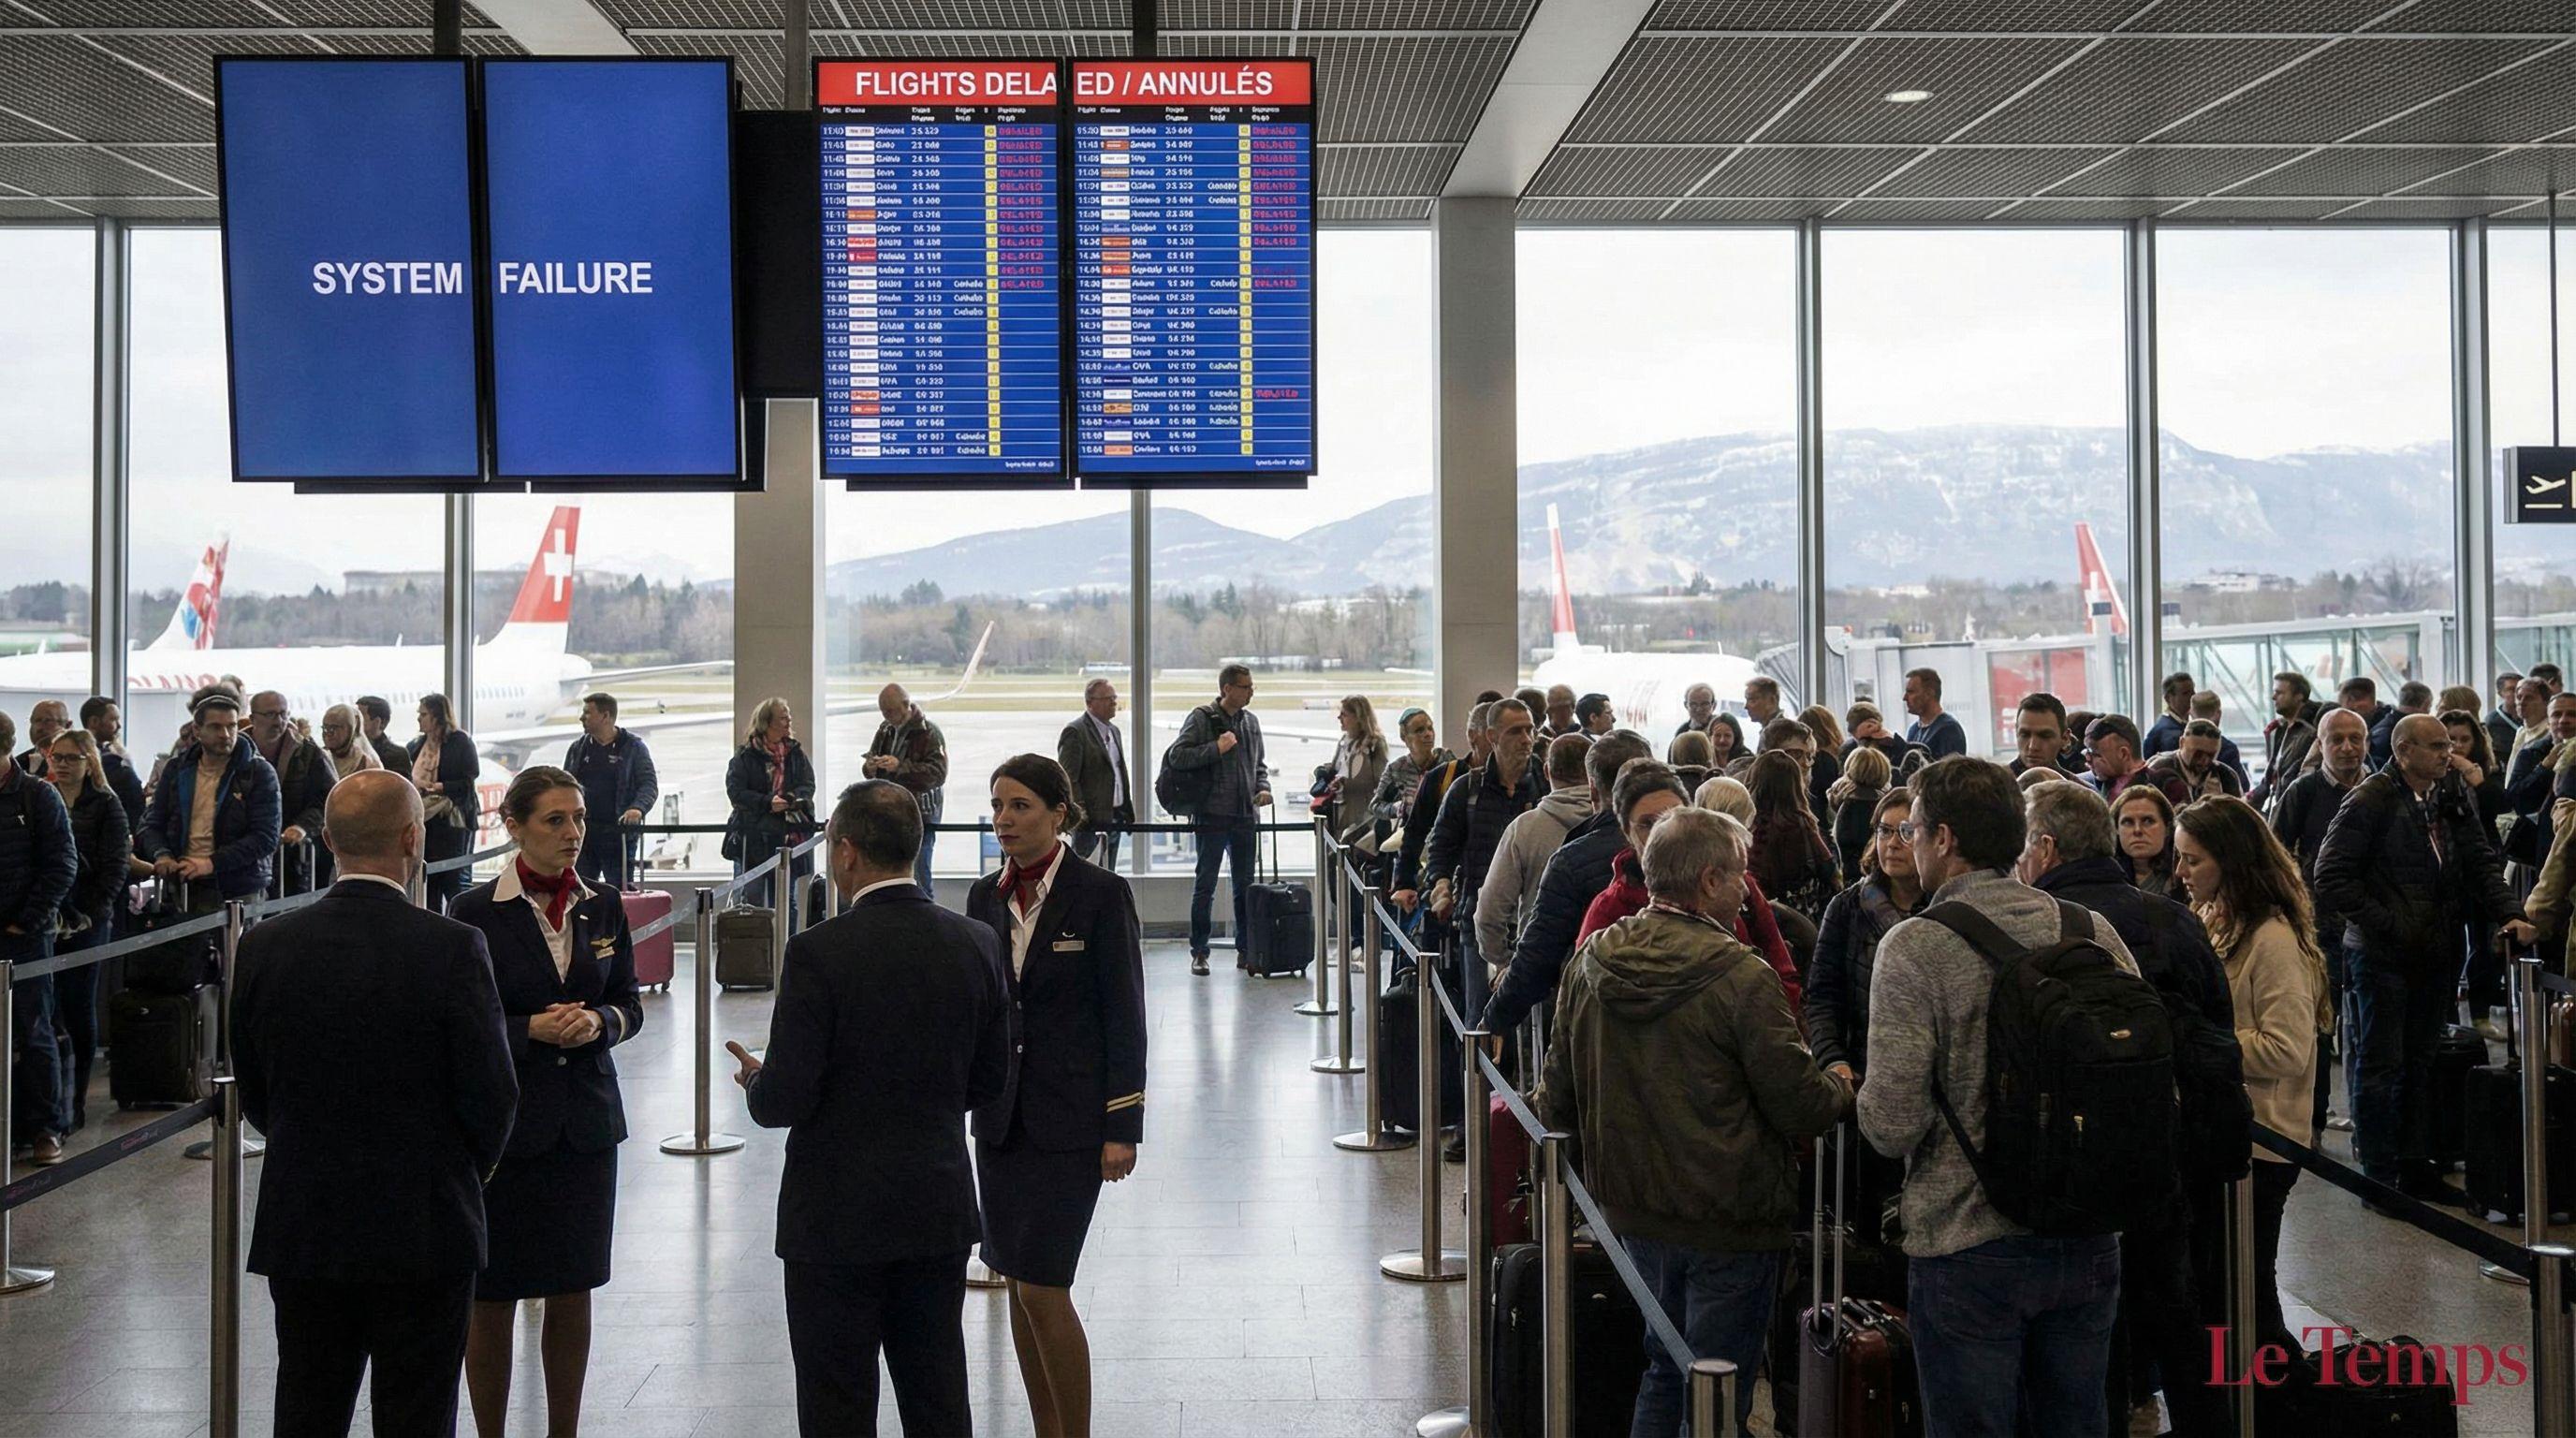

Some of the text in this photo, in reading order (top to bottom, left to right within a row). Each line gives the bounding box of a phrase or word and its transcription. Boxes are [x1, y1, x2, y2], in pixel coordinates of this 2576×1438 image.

[856, 65, 1273, 95] FLIGHTS DELA ED / ANNULÉS
[313, 262, 652, 294] SYSTEM FAILURE
